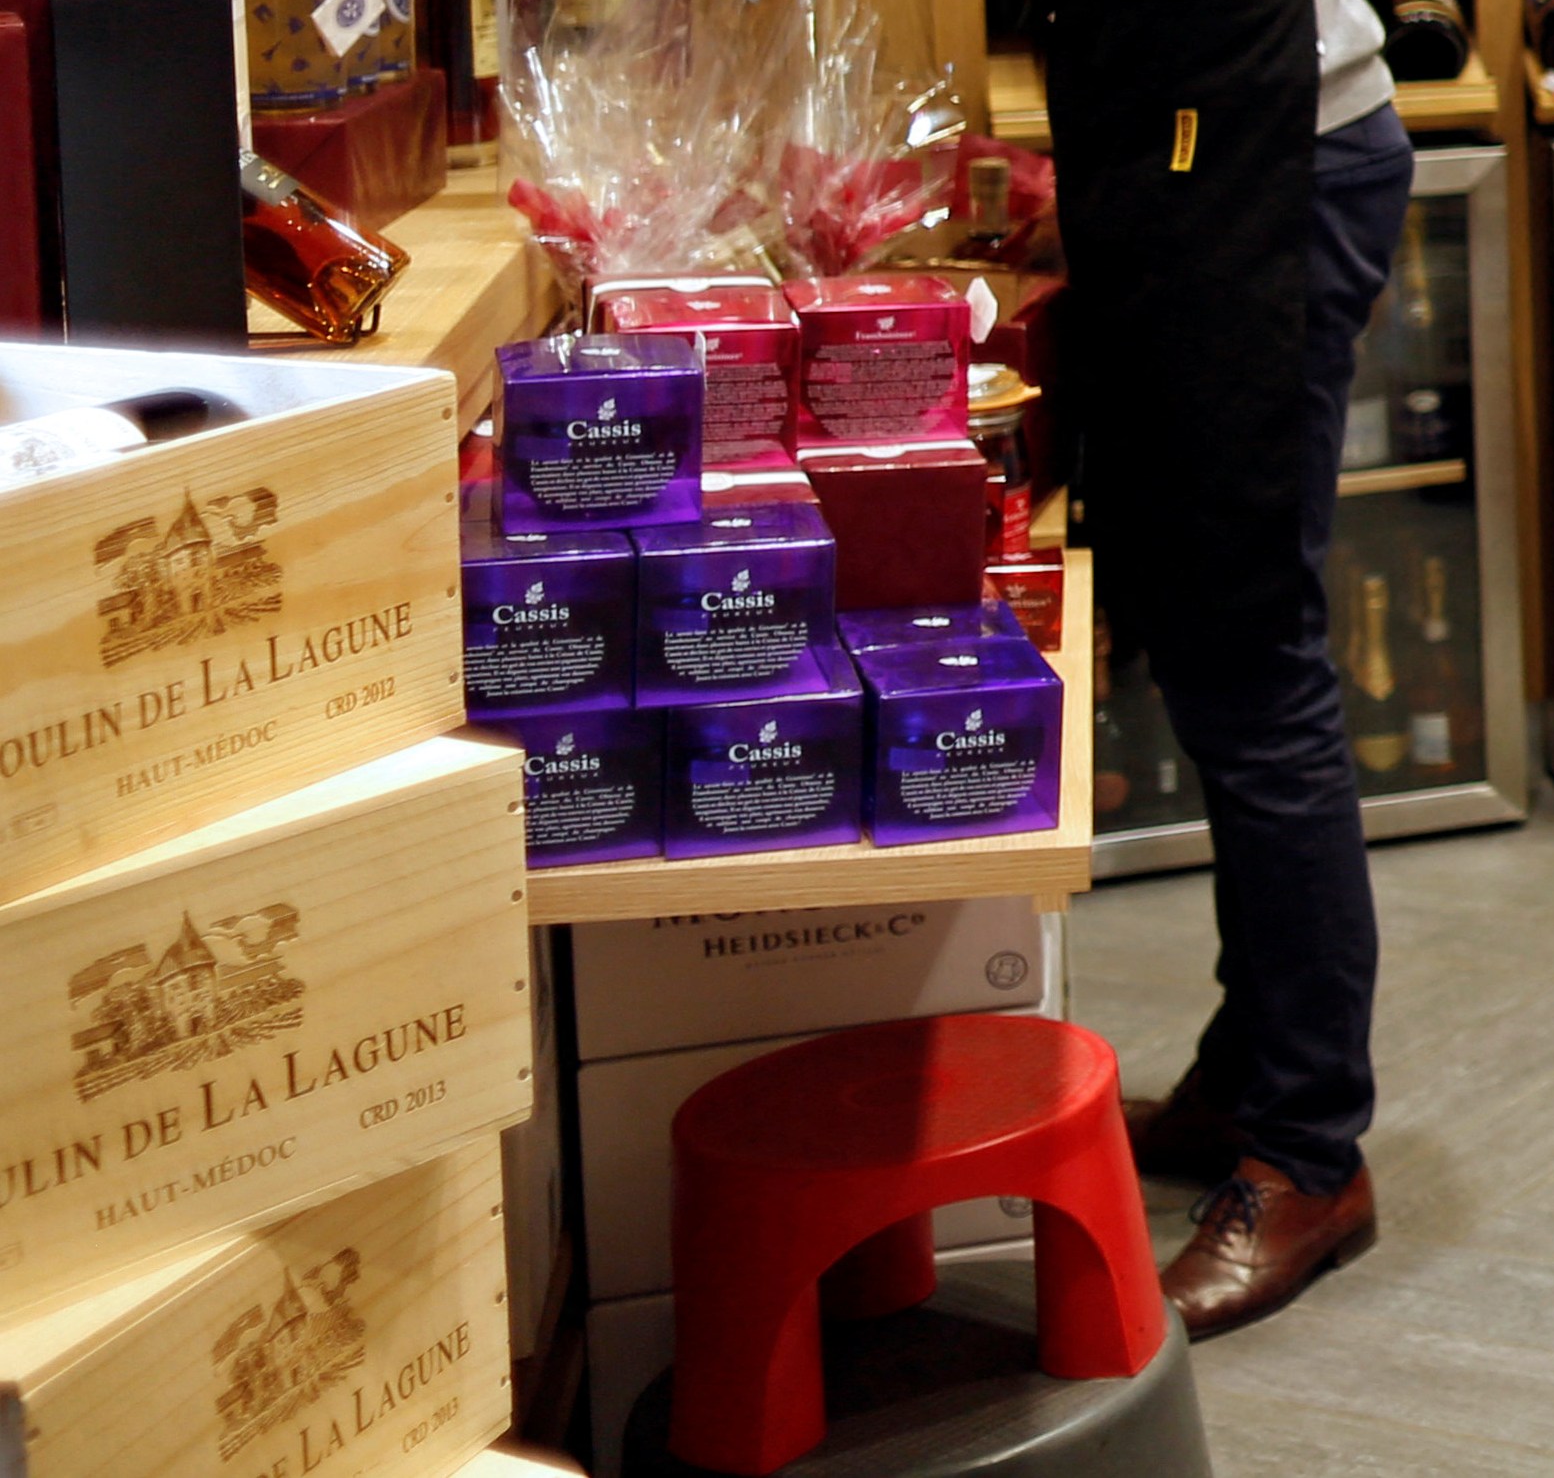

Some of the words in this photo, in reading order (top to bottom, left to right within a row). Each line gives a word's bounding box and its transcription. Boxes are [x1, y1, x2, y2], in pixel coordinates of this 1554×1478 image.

[567, 419, 641, 440] Cassis
[701, 590, 775, 611] Cassis
[492, 602, 570, 626] Cassis
[0, 702, 124, 778] OULIN
[138, 680, 187, 730] DE
[201, 657, 255, 708] LA
[266, 601, 414, 685] LAGUNE
[116, 721, 278, 798] HAUT-MÉDOC
[325, 690, 358, 721] CRD
[361, 675, 397, 711] 2012
[935, 728, 1007, 751] Cassis
[524, 752, 600, 777] Cassis
[728, 740, 802, 764] Cassis
[121, 1106, 183, 1162] DE
[200, 1079, 269, 1133] LA
[284, 1003, 467, 1103] LAGUNE
[95, 1137, 298, 1230] HAUT-MÉDOC
[359, 1099, 399, 1131] CRD
[404, 1080, 447, 1114] 2013
[299, 1419, 345, 1477] LA
[352, 1321, 472, 1438] LAGUNE
